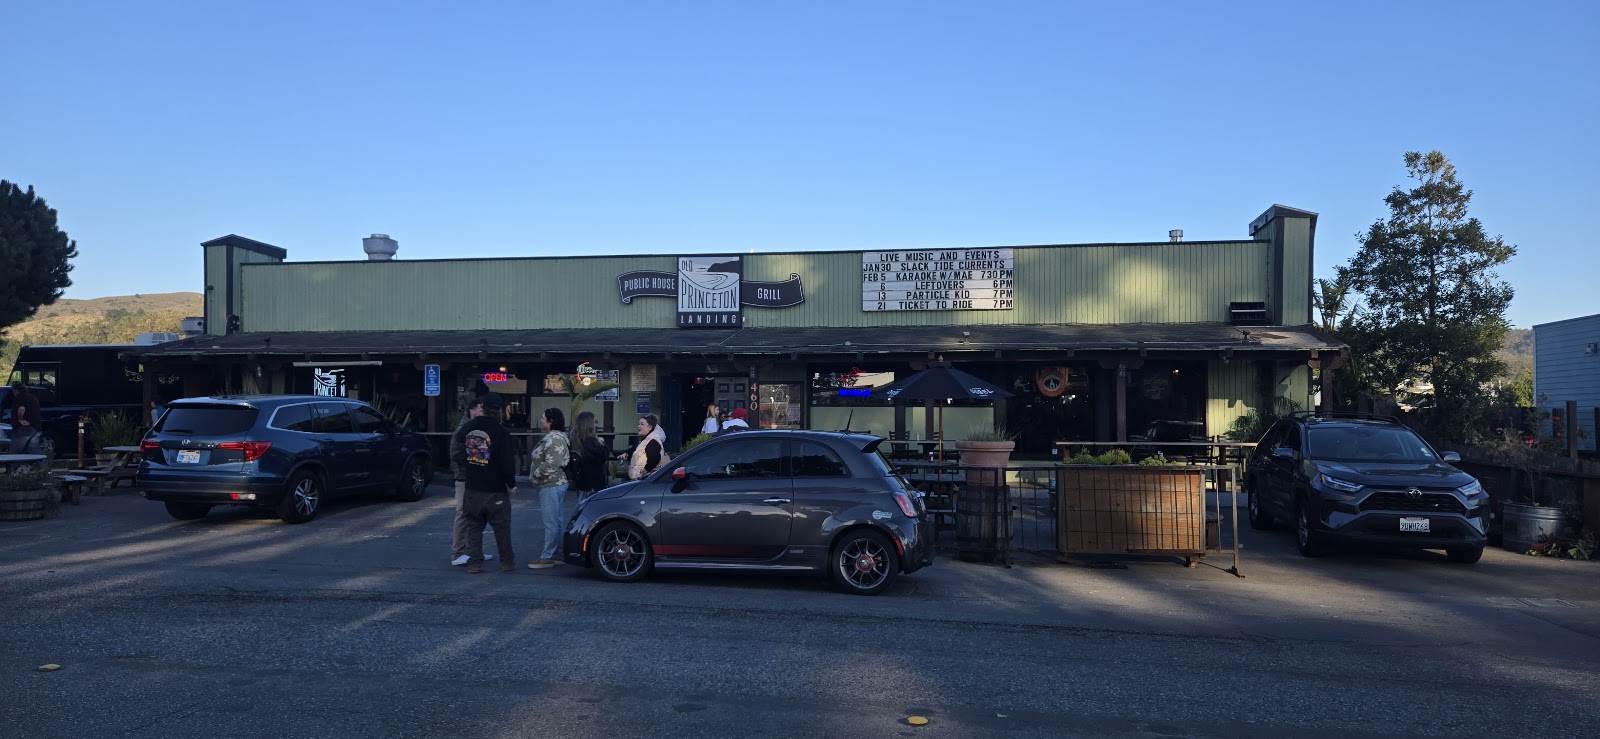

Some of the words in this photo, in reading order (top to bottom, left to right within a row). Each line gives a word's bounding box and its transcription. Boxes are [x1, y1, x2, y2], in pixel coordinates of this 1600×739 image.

[880, 253, 899, 262] LIVE
[905, 252, 934, 261] MUSIC
[940, 251, 958, 260] AND
[965, 250, 1000, 260] EVENTS
[681, 260, 693, 272] OLD
[900, 262, 929, 271] SLACK
[934, 261, 954, 270] TIDE
[958, 260, 1005, 270] CURRENTS
[863, 273, 879, 282] FEB
[880, 273, 886, 281] 5
[896, 271, 937, 281] KARAOKE
[624, 277, 650, 292] PUBLIC
[652, 277, 675, 290] HOUSE
[880, 282, 886, 291] 6
[915, 280, 965, 290] LEFTOVERS
[681, 278, 737, 309] PRINCETON
[757, 287, 781, 300] GRILL
[878, 291, 886, 301] 13
[906, 290, 950, 300] PARTICLE
[954, 290, 970, 299] KID
[877, 301, 886, 310] 21
[899, 300, 930, 310] TICKET
[936, 300, 947, 309] TO
[952, 299, 973, 309] RIDE
[680, 314, 737, 324] LANDING
[484, 373, 508, 382] OPEN
[313, 378, 346, 397] PRINCETN
[750, 382, 758, 411] 460
